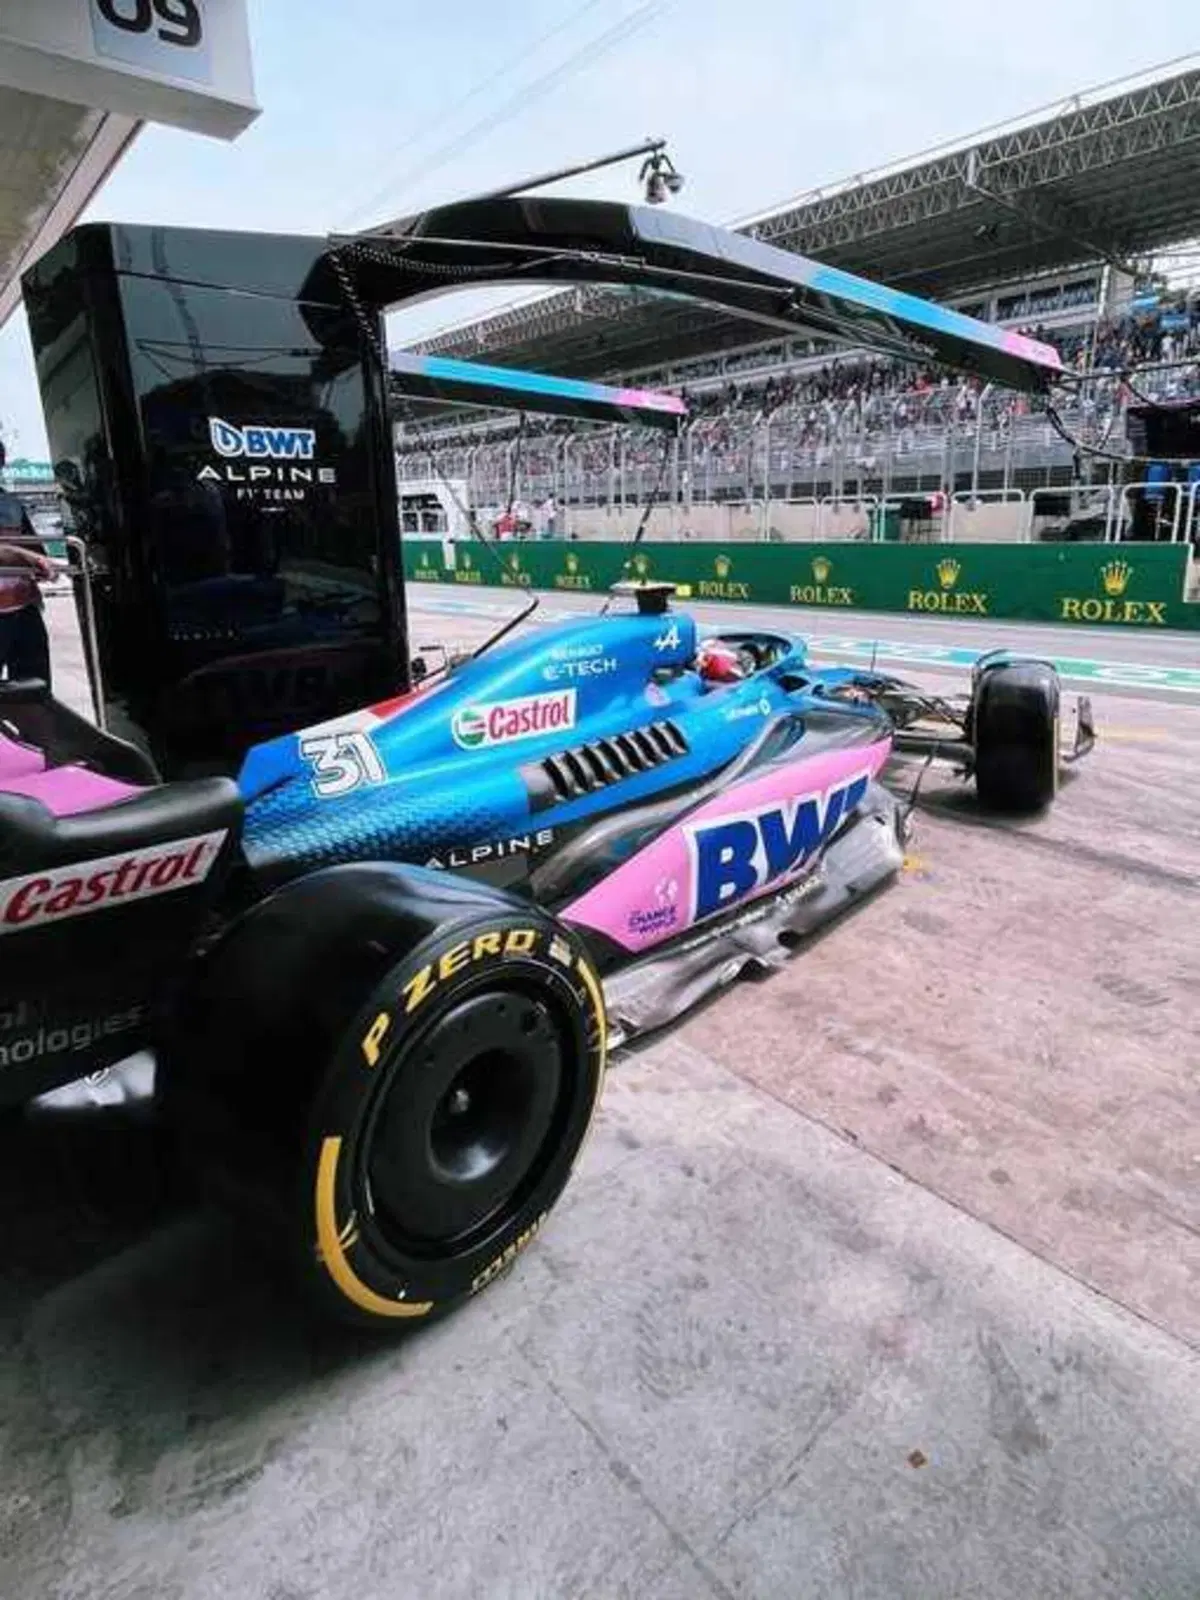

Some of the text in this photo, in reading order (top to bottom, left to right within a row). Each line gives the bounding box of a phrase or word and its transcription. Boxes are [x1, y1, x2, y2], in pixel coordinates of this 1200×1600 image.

[243, 426, 315, 458] BWT
[197, 465, 336, 483] ALPINE
[263, 488, 305, 500] TEAM
[700, 580, 749, 598] ROLEX
[790, 585, 853, 604] ROLEX
[908, 590, 988, 613] ROLEX
[1061, 597, 1167, 624] ROLEX
[488, 695, 570, 740] Castrol
[300, 731, 386, 797] 31
[425, 828, 553, 870] ALPINE
[3, 842, 208, 924] Castrol
[362, 1012, 390, 1067] P
[402, 929, 536, 1013] ZERO
